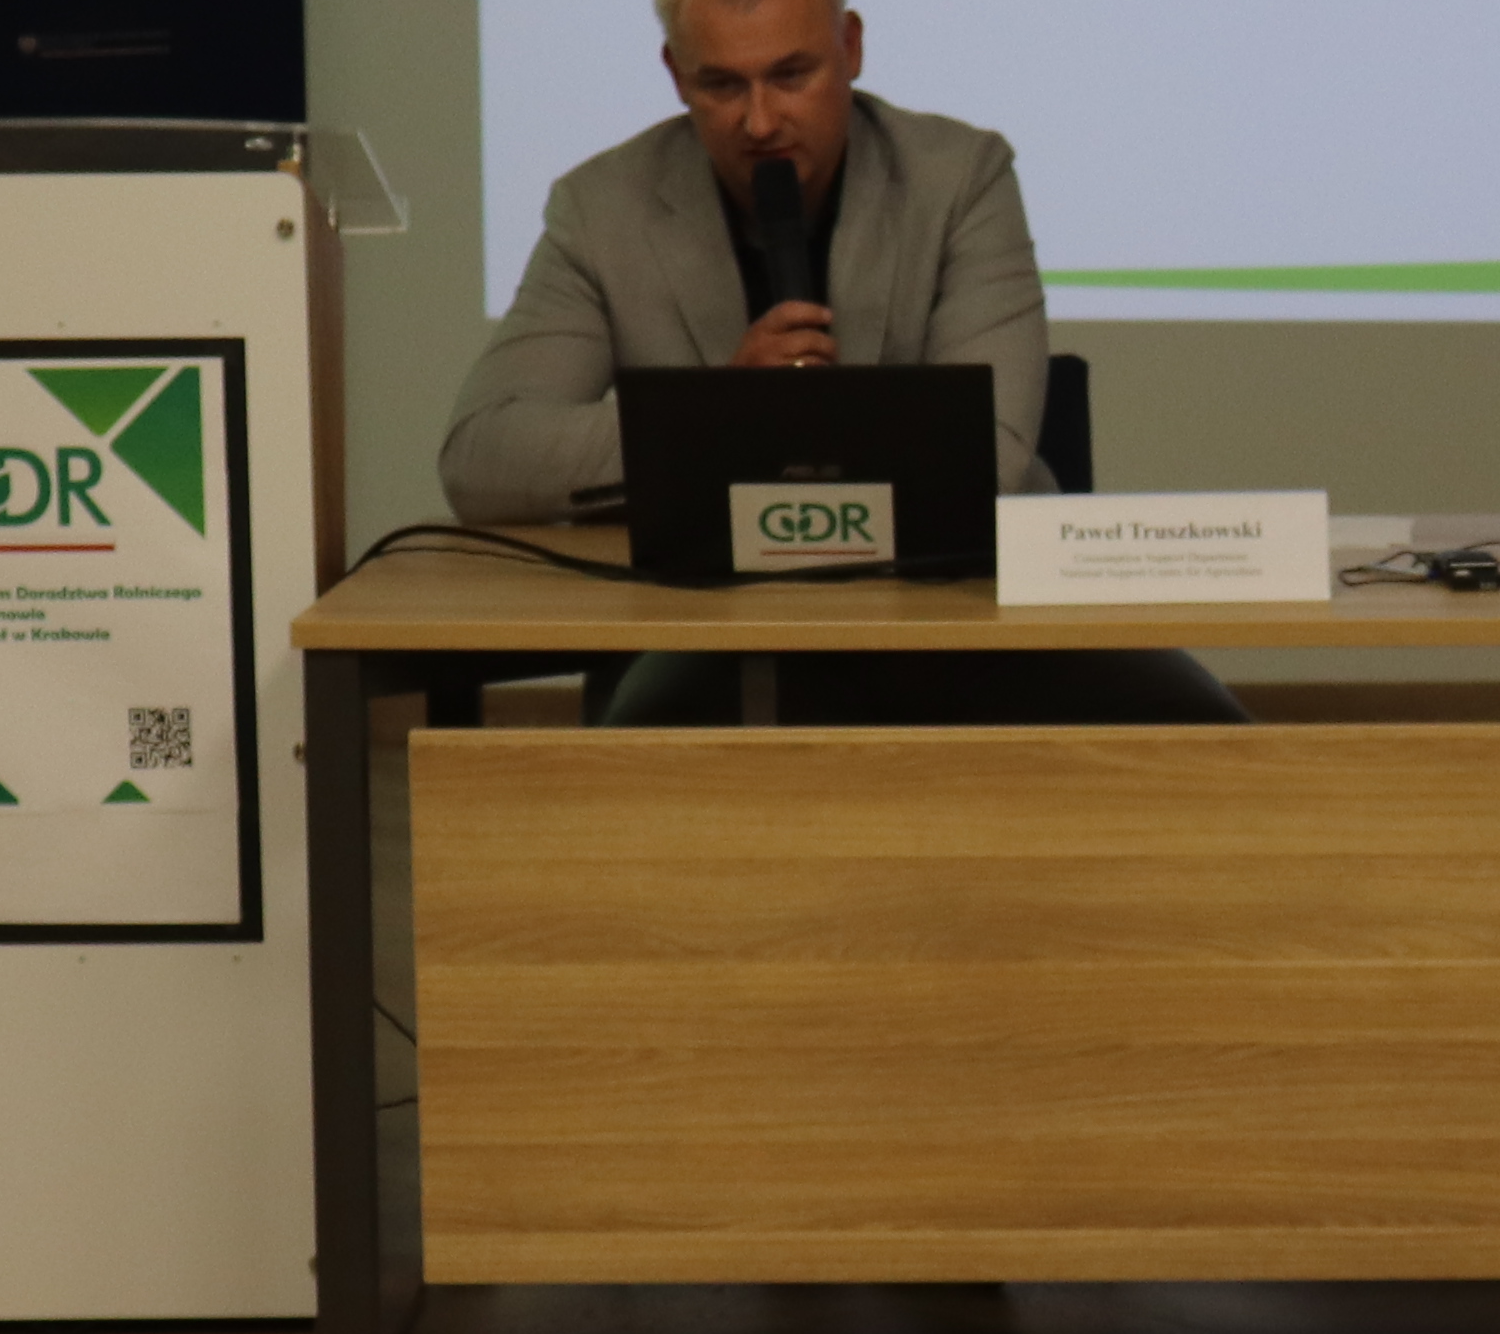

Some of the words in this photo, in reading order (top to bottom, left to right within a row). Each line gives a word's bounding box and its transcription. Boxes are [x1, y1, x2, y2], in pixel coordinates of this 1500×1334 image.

[1061, 522, 1122, 540] Paweł
[1129, 520, 1262, 539] Truszkowski
[112, 585, 202, 601] Rolniczego
[11, 630, 26, 641] w
[31, 628, 111, 642] Krakowie
